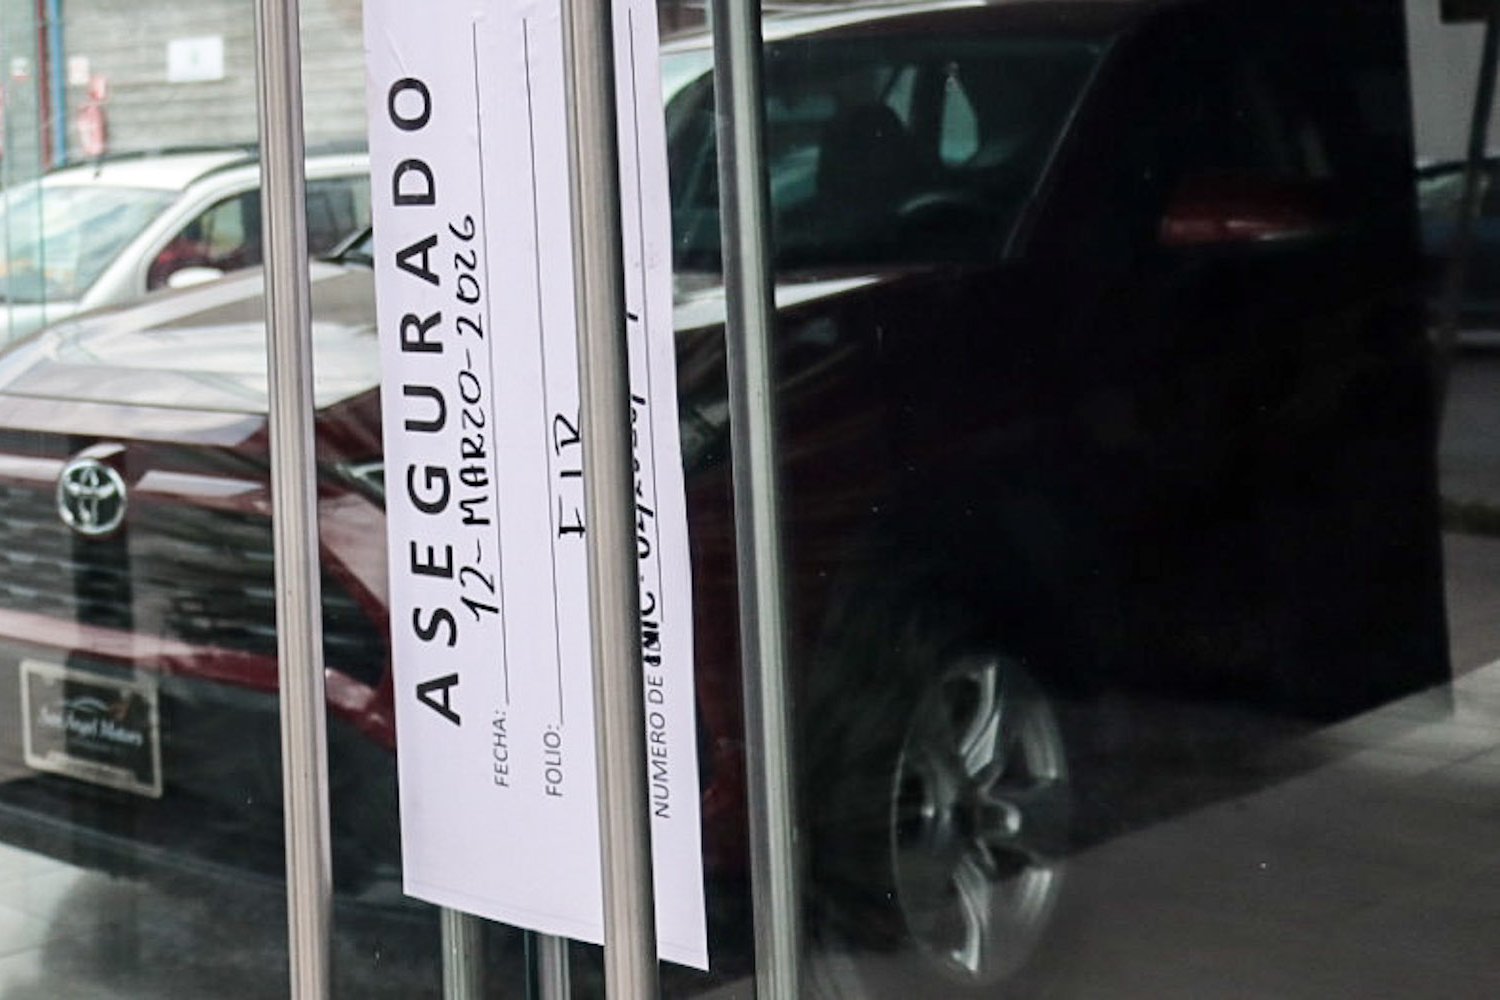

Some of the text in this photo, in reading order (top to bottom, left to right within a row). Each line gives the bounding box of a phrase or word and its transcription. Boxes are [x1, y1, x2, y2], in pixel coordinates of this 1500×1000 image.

[387, 77, 461, 727] ASEGURADO
[646, 675, 664, 704] DE
[492, 710, 510, 788] FECHA:
[542, 724, 563, 798] FOLIO:
